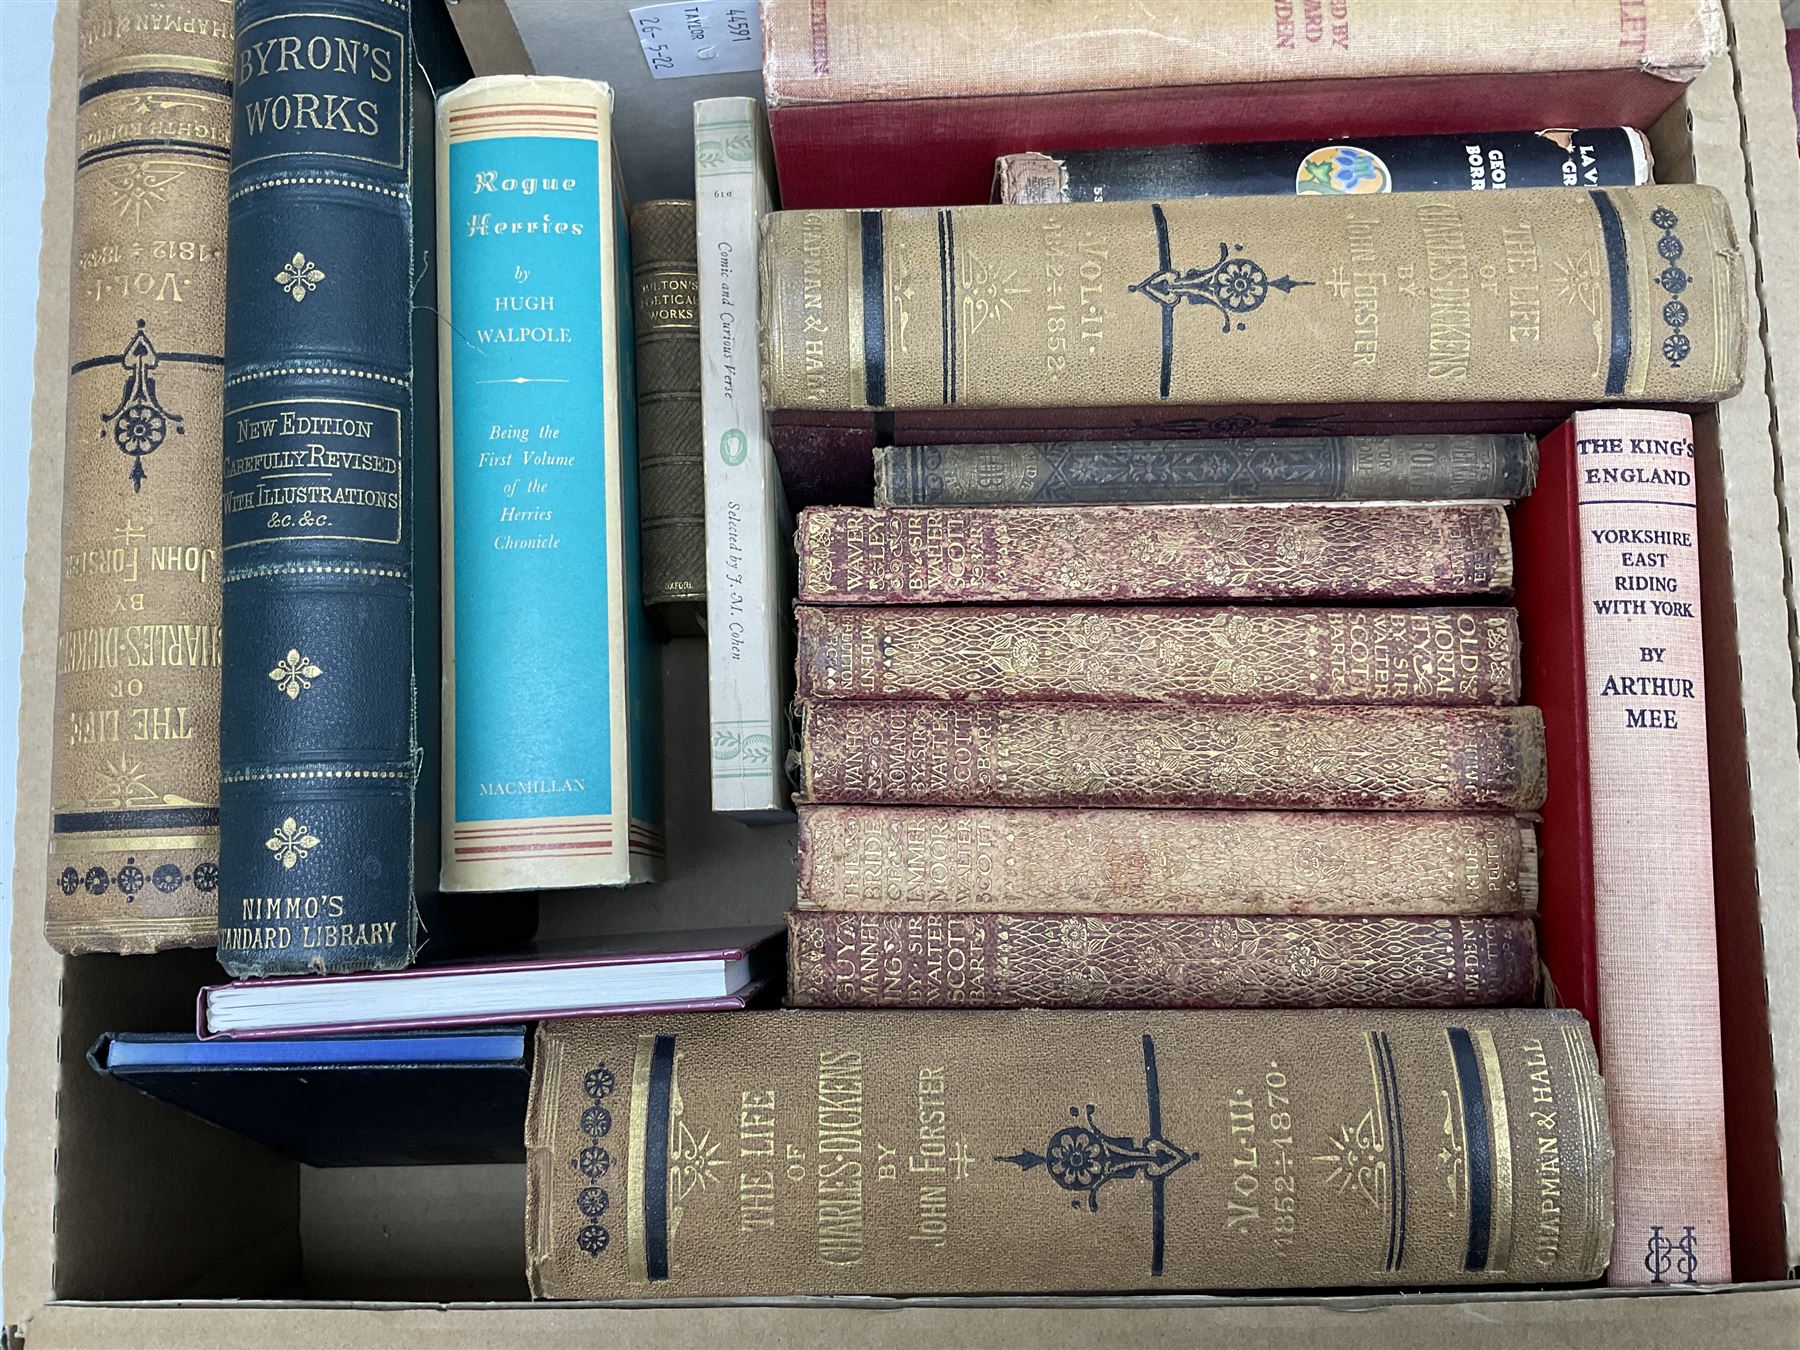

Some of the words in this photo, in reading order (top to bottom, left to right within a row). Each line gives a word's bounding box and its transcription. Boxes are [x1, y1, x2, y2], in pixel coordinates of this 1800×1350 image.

[684, 7, 704, 40] TAYLOR
[726, 9, 752, 42] 44591
[1333, 22, 1348, 50] BY
[239, 36, 392, 87] BYRON'S
[246, 94, 378, 136] WORKS
[474, 170, 576, 195] Rogue
[466, 213, 584, 237] Herries
[1348, 219, 1379, 261] JOHN
[717, 241, 733, 279] Comic
[1502, 223, 1537, 274] THE
[514, 266, 530, 283] by
[1397, 265, 1415, 297] BY
[1480, 265, 1498, 295] OF
[495, 296, 554, 312] HUGH
[721, 282, 734, 307] and
[650, 309, 693, 321] WORKS
[802, 314, 828, 333] &
[1354, 272, 1387, 365] FORSTER
[1509, 285, 1541, 342] LIFE
[477, 327, 572, 343] WALPOLE
[720, 312, 735, 359] Curious
[724, 363, 736, 399] Verse
[236, 419, 278, 443] NEW
[280, 412, 373, 438] EDITION
[489, 425, 529, 443] Being
[539, 424, 560, 439] the
[224, 451, 309, 478] CAREFULLY
[307, 444, 397, 474] REVISED
[478, 452, 512, 468] First
[523, 451, 575, 466] Volume
[1577, 438, 1623, 455] THE
[1630, 439, 1695, 459] KING'S
[504, 479, 520, 498] of
[527, 479, 548, 493] the
[1585, 468, 1691, 486] ENGLAND
[223, 491, 254, 515] WITH
[257, 484, 399, 509] ILLUSTRATIONS
[500, 506, 553, 522] Herries
[494, 534, 560, 550] Chronicle
[728, 501, 741, 551] Selected
[868, 516, 884, 560] LEY
[909, 517, 922, 547] SIR
[1591, 529, 1692, 547] YORKSHIRE
[152, 547, 215, 582] JOHN
[725, 554, 743, 570] by
[847, 516, 864, 591] WAVER
[927, 516, 943, 589] WALTER
[947, 517, 965, 590] SCOTT
[1621, 552, 1669, 568] EAST
[725, 574, 743, 588] J.
[909, 565, 922, 590] BY
[1615, 576, 1678, 592] RIDING
[111, 593, 144, 612] BY
[730, 591, 743, 617] M.
[1593, 600, 1646, 616] WITH
[1650, 600, 1695, 618] YORK
[728, 622, 743, 660] Cohen
[1328, 613, 1345, 670] BART
[1391, 615, 1408, 643] BY
[1411, 616, 1432, 656] ITY
[1457, 614, 1478, 672] OLD
[1348, 614, 1369, 696] SCOTT
[1373, 614, 1388, 698] WALTER
[1433, 615, 1456, 698] MORTAL
[1640, 647, 1667, 663] BY
[111, 679, 142, 697] OF
[1393, 657, 1408, 697] SIR
[1600, 675, 1695, 699] ARTHUR
[70, 709, 120, 745] LIFE
[132, 707, 191, 740] THE
[871, 711, 884, 722] A
[1626, 709, 1678, 729] MEE
[845, 708, 864, 791] IVANHOE
[889, 708, 906, 791] ROMANCE
[932, 708, 948, 791] WALTER
[954, 711, 972, 791] SCOTT
[977, 712, 992, 769] BART
[479, 778, 586, 796] MACMILLAN
[844, 853, 860, 902] THE
[863, 820, 883, 900] BRIDE
[906, 818, 926, 902] LAMMER
[930, 819, 948, 903] MOOR
[956, 820, 971, 903] WALTER
[976, 821, 992, 902] SCOTT
[887, 868, 901, 900] OF
[243, 895, 344, 921] NIMMO'S
[219, 927, 291, 951] TANDARD
[303, 921, 396, 948] LIBRARY
[908, 916, 923, 954] SIR
[836, 937, 856, 1000] GUY
[861, 915, 879, 1001] MANNER
[927, 915, 942, 1001] WALTER
[947, 915, 966, 1001] SCOTT
[969, 940, 985, 1001] BART
[884, 958, 902, 1000] ING
[908, 973, 922, 1000] BY
[1523, 1039, 1553, 1103] HALL
[740, 1090, 775, 1157] LIFE
[909, 1066, 947, 1172] FORSTER
[1530, 1112, 1557, 1130] &
[786, 1144, 805, 1180] OF
[879, 1142, 896, 1180] BY
[740, 1170, 775, 1231] THE
[909, 1186, 947, 1246] JOHN
[1537, 1138, 1560, 1264] CHAPMAN
